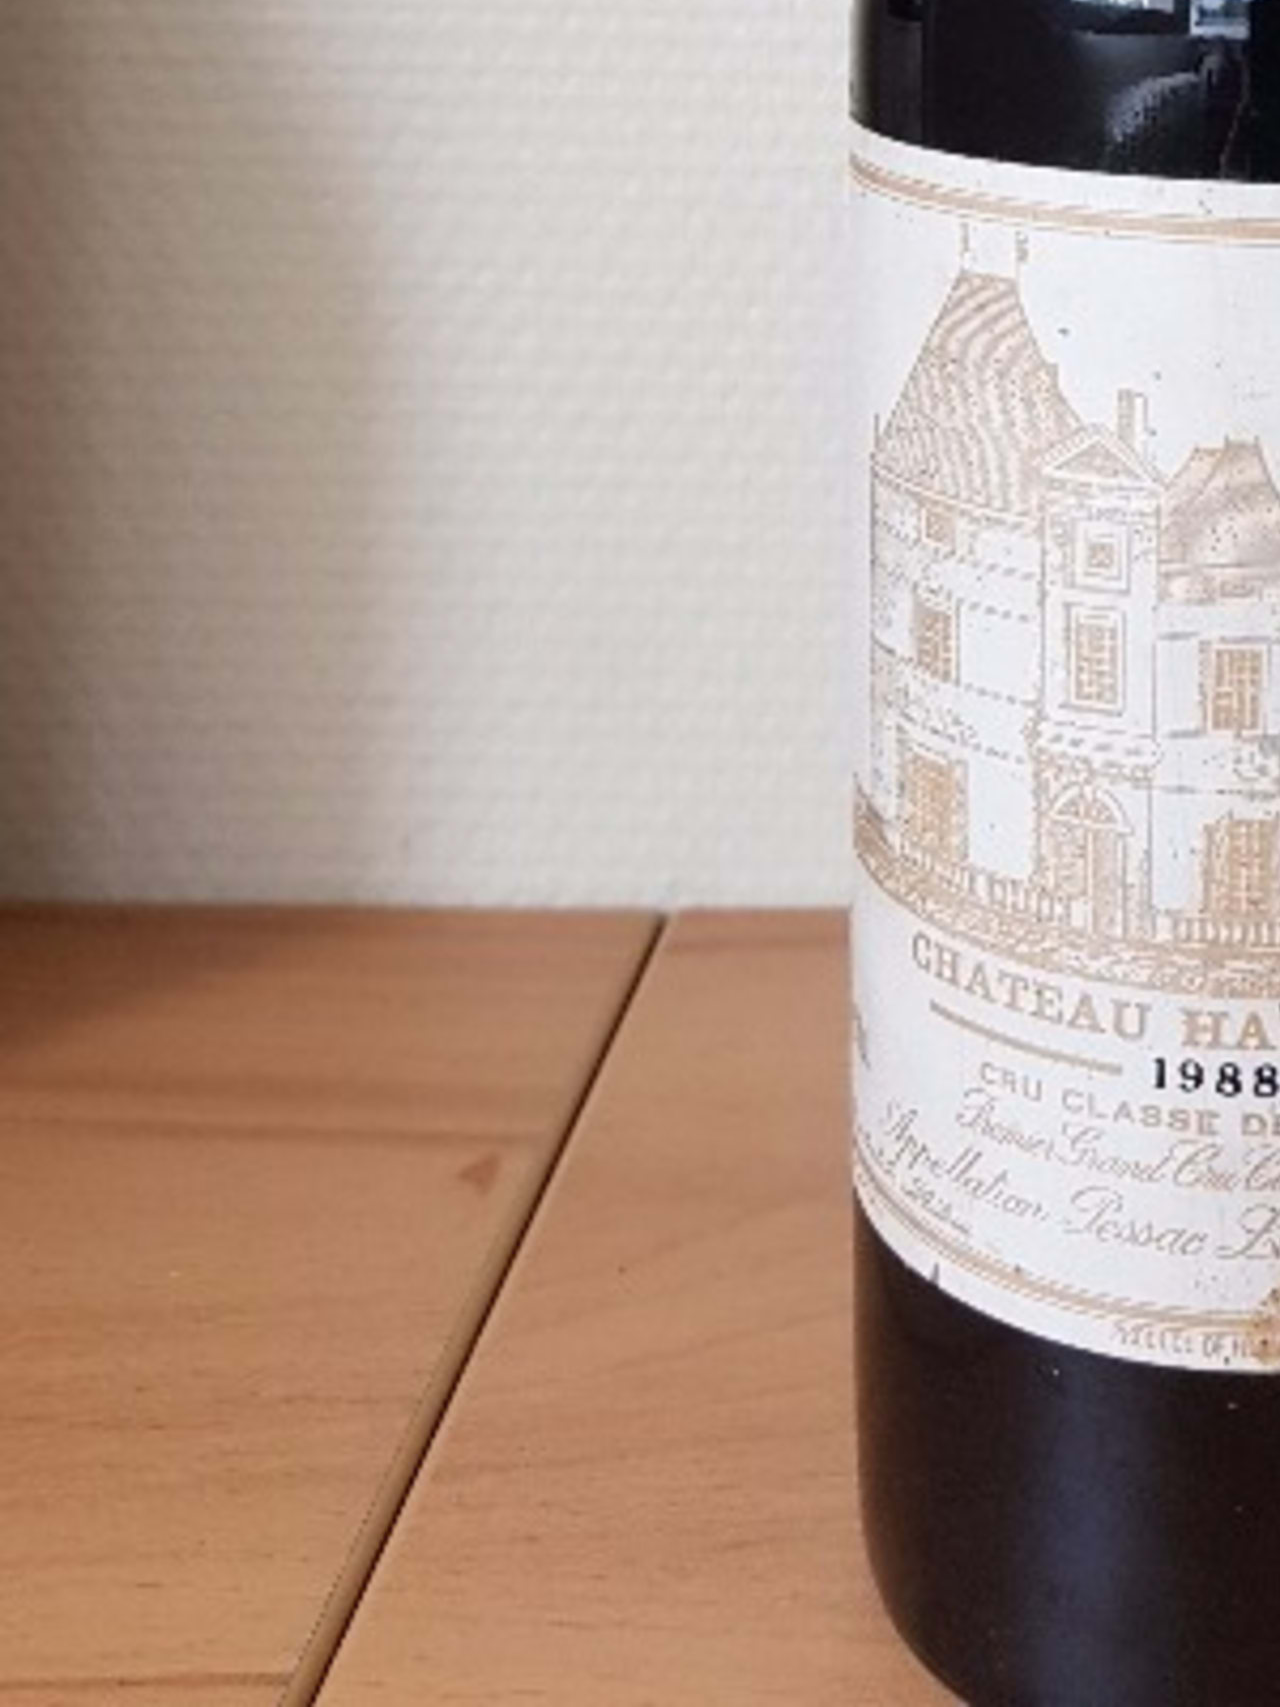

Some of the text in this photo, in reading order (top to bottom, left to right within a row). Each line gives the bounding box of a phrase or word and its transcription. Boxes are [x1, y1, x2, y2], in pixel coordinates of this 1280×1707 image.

[911, 931, 1153, 1042] CHATEAU
[980, 1061, 1043, 1102] CRU
[1061, 1088, 1222, 1138] CLASSE
[1153, 1057, 1280, 1098] 1988
[882, 1102, 1050, 1222] Appellation
[1063, 1186, 1210, 1256] Pessac
[955, 1087, 1055, 1161] Premier
[1058, 1121, 1174, 1185] Grand
[1170, 1139, 1239, 1192] Cru
